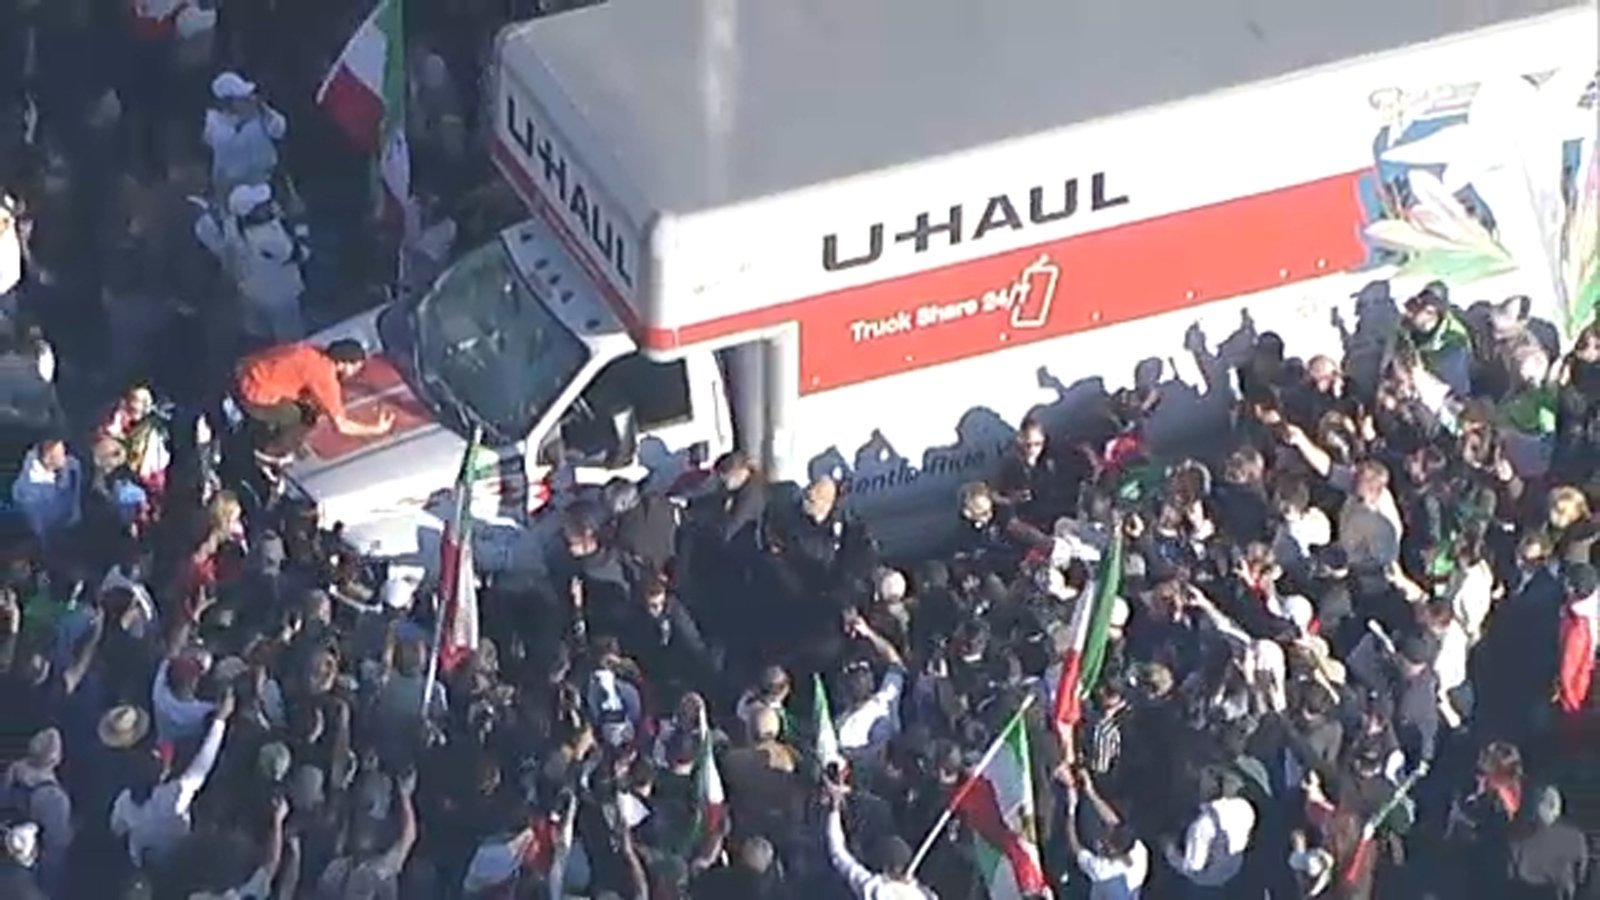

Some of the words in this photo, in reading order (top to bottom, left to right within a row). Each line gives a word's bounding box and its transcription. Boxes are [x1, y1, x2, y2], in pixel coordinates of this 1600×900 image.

[506, 95, 634, 289] U-HAUL
[822, 171, 1130, 272] U-HAUL
[850, 311, 913, 342] Truck
[915, 298, 979, 327] Share
[982, 282, 1031, 312] 24/7
